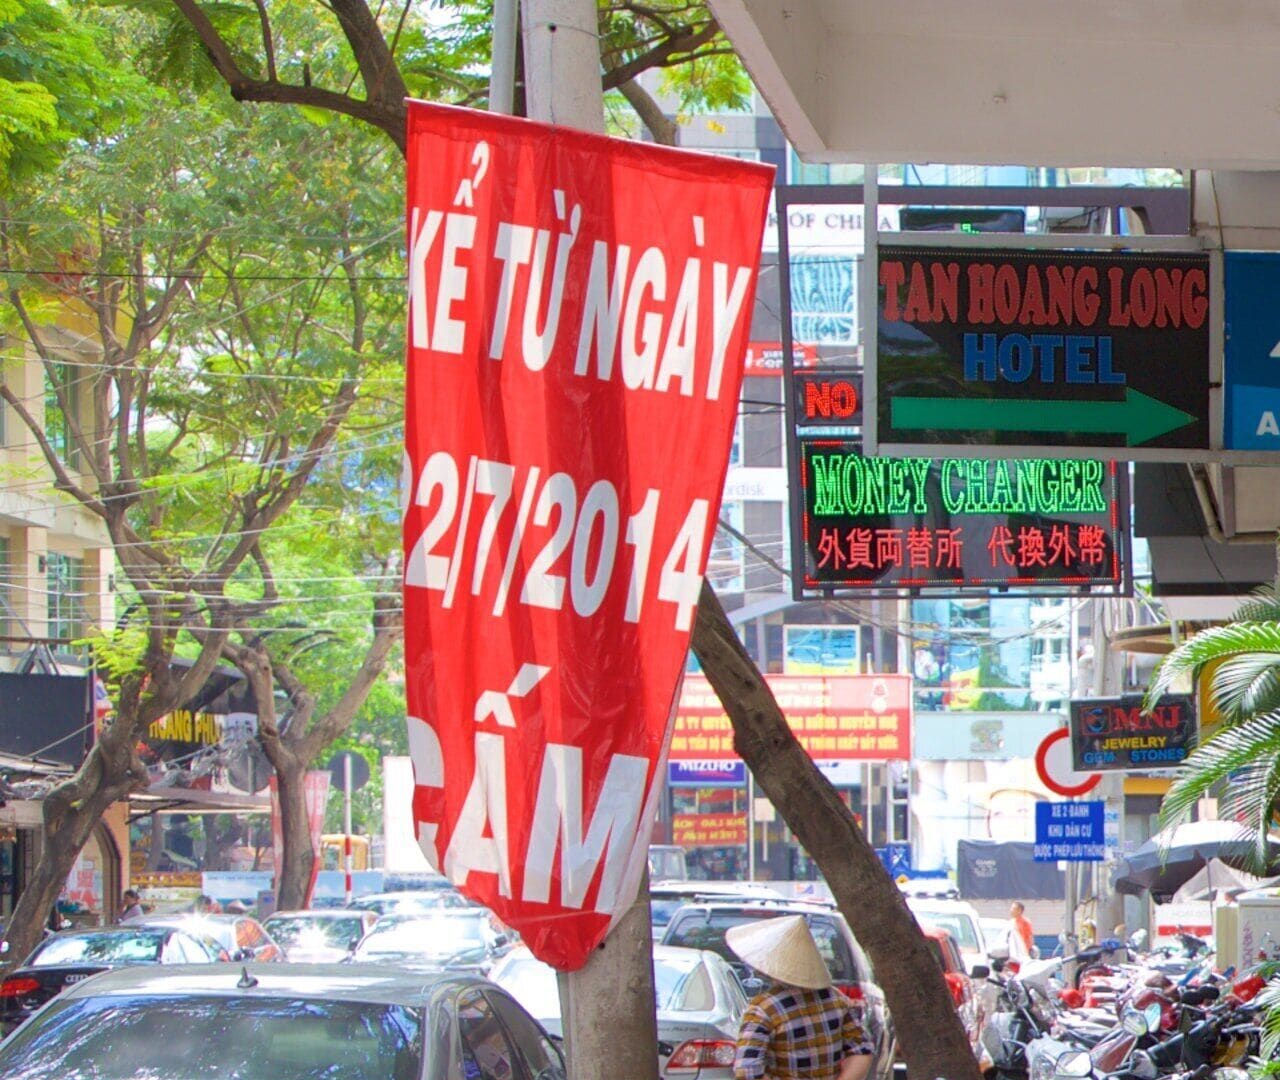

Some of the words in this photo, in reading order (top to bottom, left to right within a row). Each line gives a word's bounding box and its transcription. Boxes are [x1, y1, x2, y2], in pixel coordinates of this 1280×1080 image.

[789, 212, 816, 229] OF
[825, 214, 893, 231] CHIA
[409, 140, 478, 355] KỂ
[489, 189, 582, 372] TỪ
[574, 215, 752, 401] NGÀY
[879, 261, 960, 324] TAN
[967, 263, 1101, 326] HOANG
[1107, 266, 1208, 329] LONG
[963, 332, 1127, 384] HOTEL
[805, 381, 857, 419] NO
[812, 454, 931, 516] MONEY
[941, 457, 1107, 515] CHANGER
[402, 450, 710, 633] 2/7/2014
[1112, 705, 1181, 731] MNJ
[1102, 736, 1167, 750] JEWELRY
[1130, 747, 1186, 763] STONES
